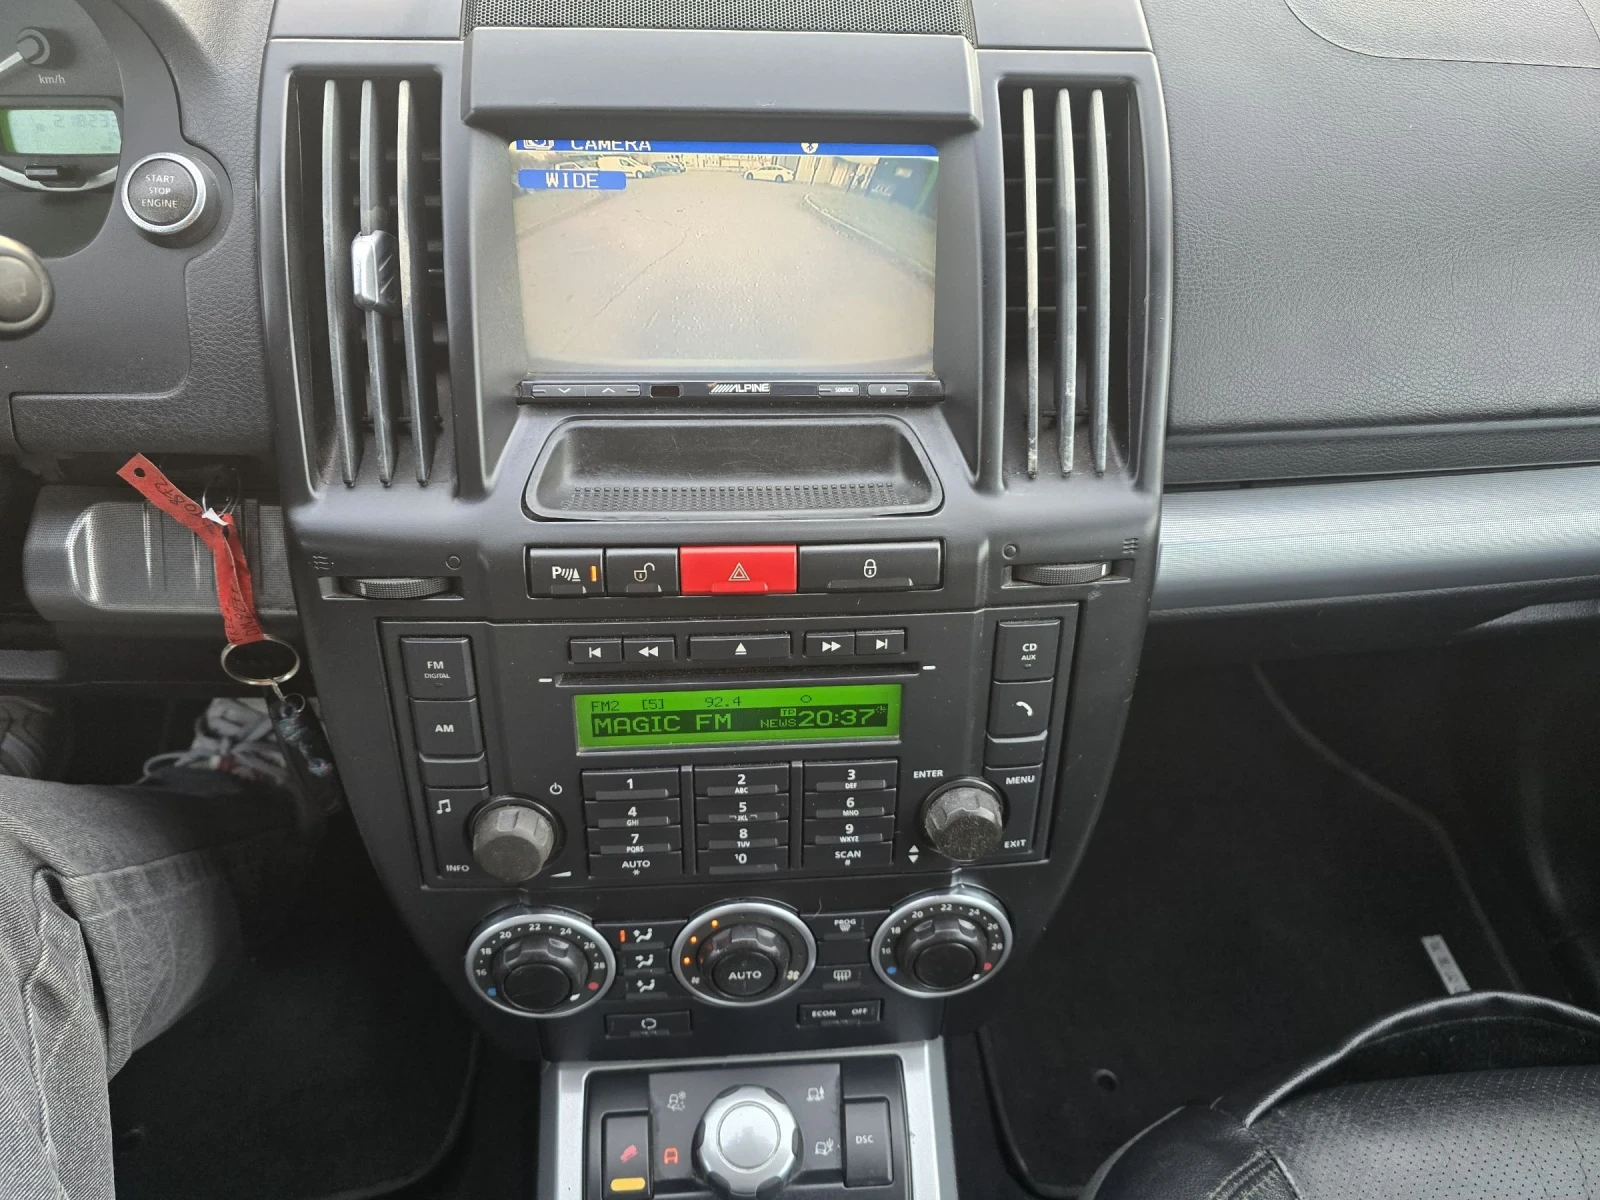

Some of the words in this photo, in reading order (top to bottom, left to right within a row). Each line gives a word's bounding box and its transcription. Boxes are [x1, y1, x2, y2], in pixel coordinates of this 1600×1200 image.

[38, 74, 66, 85] km/h
[570, 140, 652, 151] CAMERA
[145, 174, 175, 183] START
[545, 172, 600, 188] WIDE
[149, 187, 171, 195] STOP
[141, 199, 178, 209] ENGINE
[730, 383, 770, 393] ALPINE
[1022, 642, 1037, 652] CD
[427, 661, 444, 670] FM
[591, 700, 620, 712] FM2
[704, 695, 742, 708] 92.4
[782, 709, 796, 717] TP
[760, 718, 798, 728] NEWS
[799, 709, 876, 727] 20:37
[435, 724, 454, 732] AM
[594, 715, 681, 735] MAGIC
[695, 713, 732, 731] FM
[847, 769, 856, 780] 3
[913, 769, 944, 778] ENTER
[626, 778, 634, 790] 1
[737, 774, 746, 785] 2
[1005, 775, 1035, 785] MENU
[738, 802, 747, 812] 5
[846, 797, 855, 808] 6
[627, 806, 637, 817] 4
[739, 828, 748, 839] 8
[845, 823, 854, 835] 9
[630, 833, 640, 844] 7
[1004, 839, 1026, 848] EXIT
[835, 850, 861, 859] SCAN
[446, 864, 469, 872] INFO
[621, 860, 651, 868] AUTO
[912, 911, 924, 919] 20
[834, 918, 856, 926] PROG
[529, 923, 541, 931] 22
[560, 927, 572, 935] 24
[891, 926, 901, 934] 18
[499, 931, 512, 939] 20
[584, 941, 596, 949] 26
[991, 943, 1003, 951] 28
[481, 946, 492, 955] 18
[593, 961, 605, 970] 28
[476, 968, 487, 976] 16
[728, 970, 762, 980] AUTO
[812, 1009, 836, 1018] ECON
[855, 1134, 874, 1145] DSC
